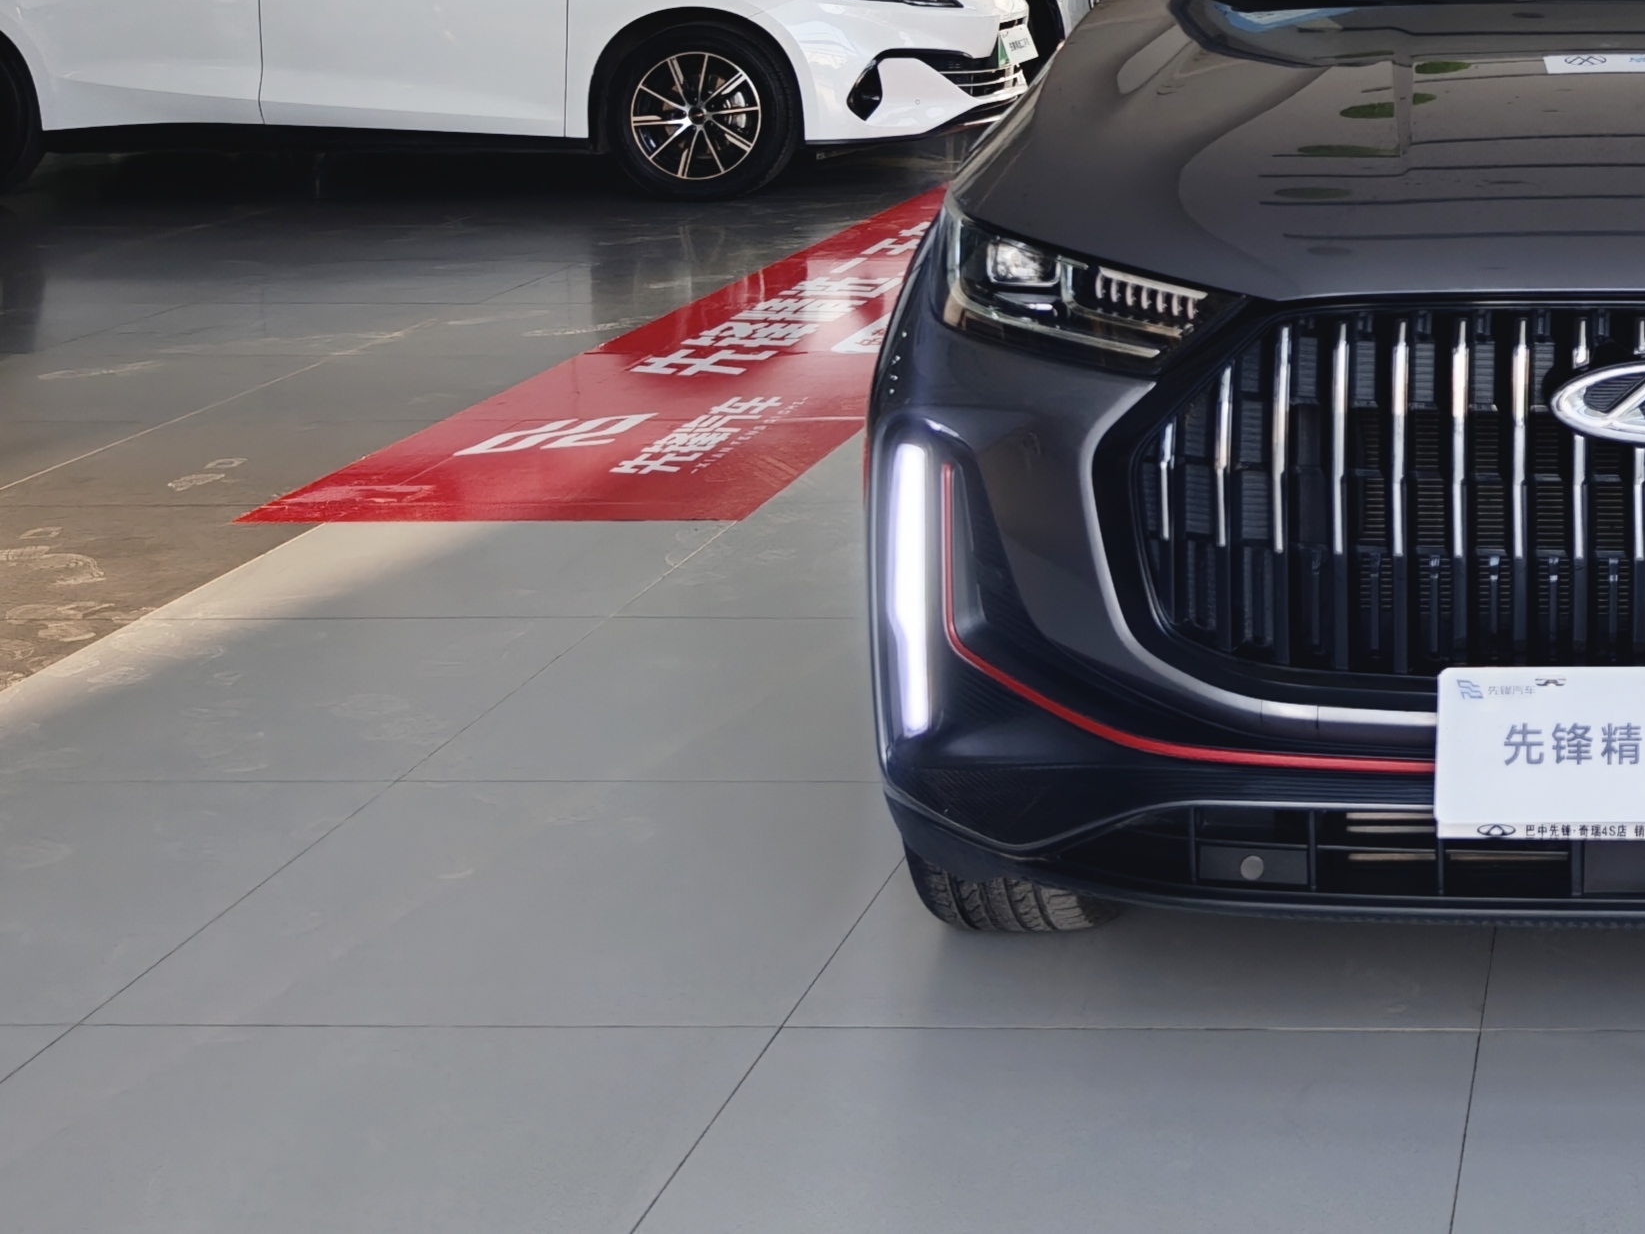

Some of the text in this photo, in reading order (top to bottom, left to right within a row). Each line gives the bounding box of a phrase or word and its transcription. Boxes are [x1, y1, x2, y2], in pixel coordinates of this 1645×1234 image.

[609, 396, 783, 475] 先锋汽车
[1487, 685, 1536, 696] 先锋汽车
[1525, 824, 1628, 838] 巴中先锋·奇瑞4S店
